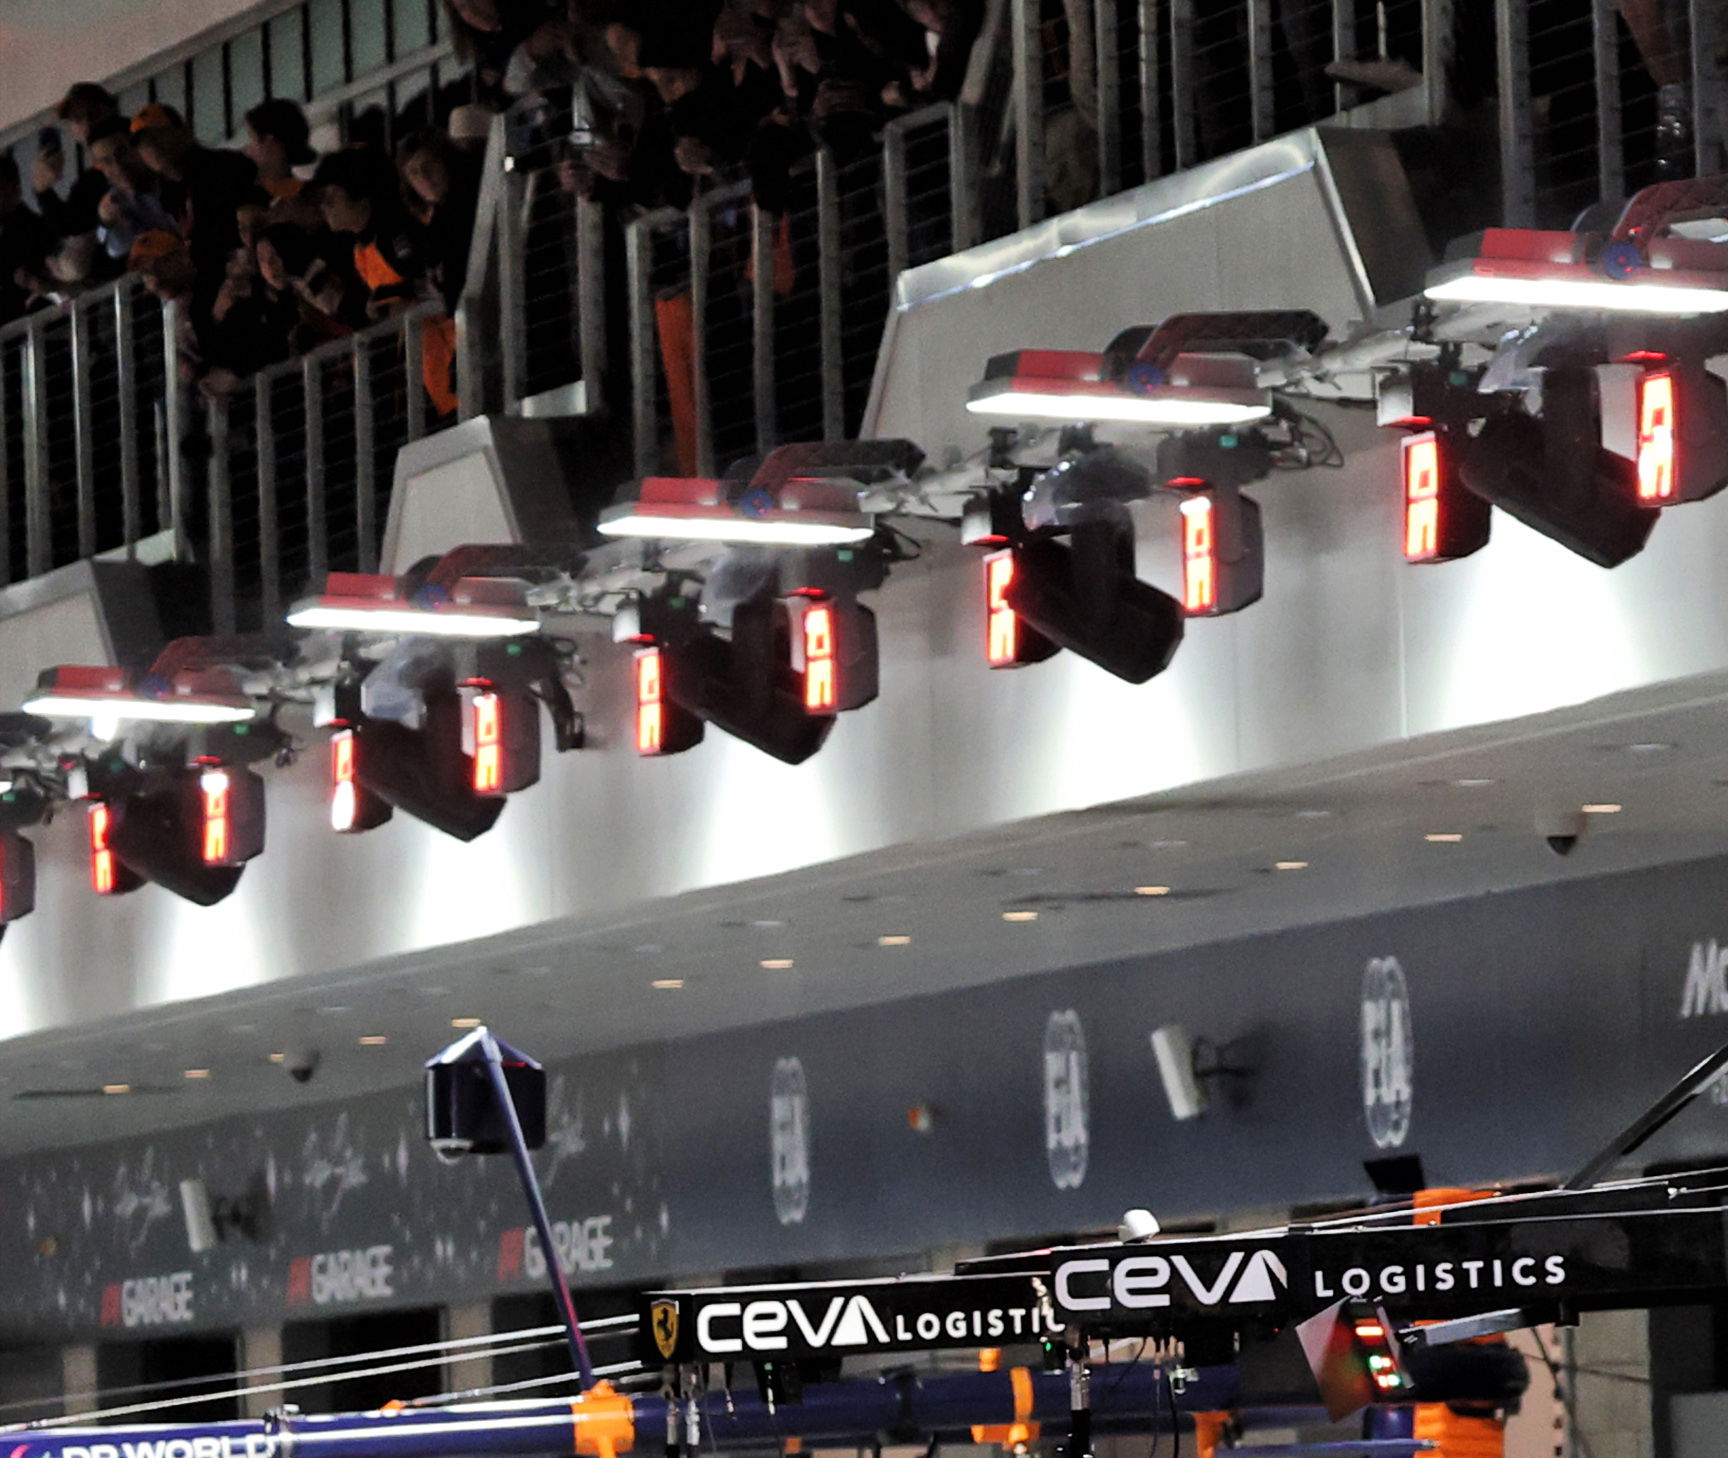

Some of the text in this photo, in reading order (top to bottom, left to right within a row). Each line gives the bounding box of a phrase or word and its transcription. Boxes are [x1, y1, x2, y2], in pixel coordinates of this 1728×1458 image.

[121, 1271, 194, 1327] GARAGE
[311, 1245, 393, 1302] GARAGE
[1314, 1253, 1567, 1299] LOGISTICS
